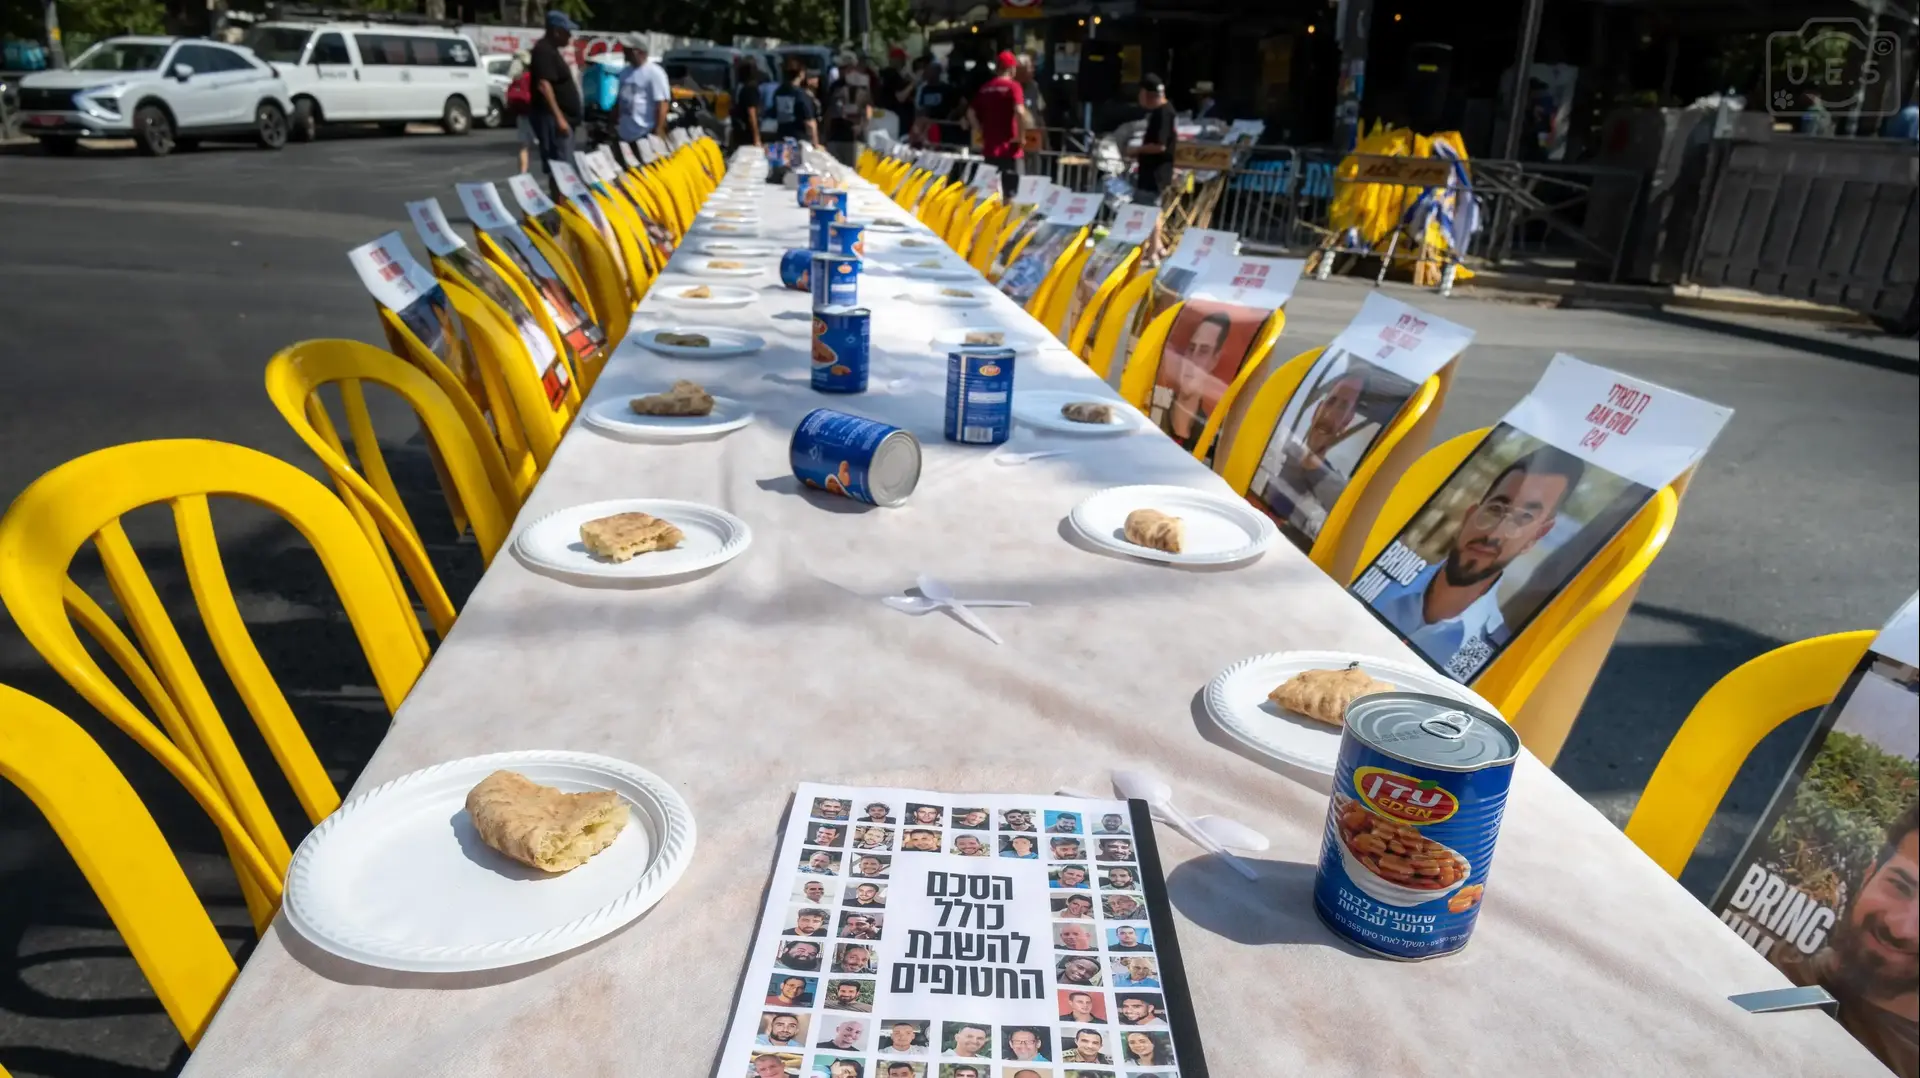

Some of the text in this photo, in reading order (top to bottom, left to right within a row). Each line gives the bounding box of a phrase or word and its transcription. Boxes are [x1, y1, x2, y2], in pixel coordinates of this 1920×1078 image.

[1585, 403, 1614, 425] RAN
[1376, 540, 1427, 586] BRING
[1367, 776, 1443, 807] עדן
[1379, 797, 1432, 818] EDEN
[926, 871, 1013, 900] הסכם
[934, 898, 1004, 930] כולל
[1338, 897, 1386, 926] עגבניות
[1339, 887, 1436, 924] שעועית לבנה
[1730, 863, 1835, 954] BRING
[1347, 920, 1361, 932] 355
[905, 929, 1030, 964] להשבת
[890, 962, 1045, 999] החטופים
